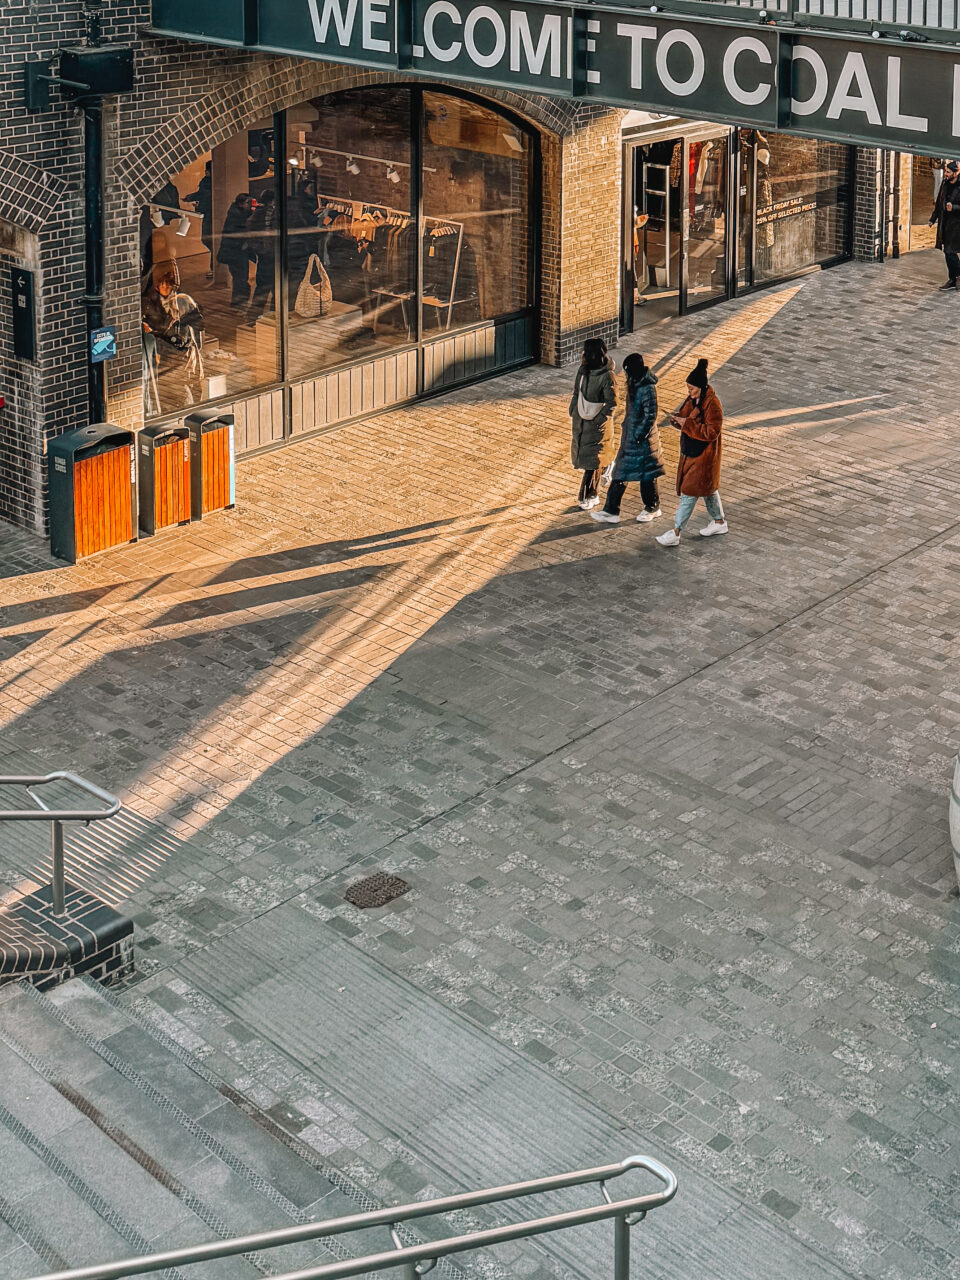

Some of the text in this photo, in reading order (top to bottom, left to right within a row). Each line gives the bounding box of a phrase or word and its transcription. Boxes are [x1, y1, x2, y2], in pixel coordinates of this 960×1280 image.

[616, 22, 706, 97] TO
[722, 36, 929, 133] COAL
[757, 206, 773, 216] BLACK
